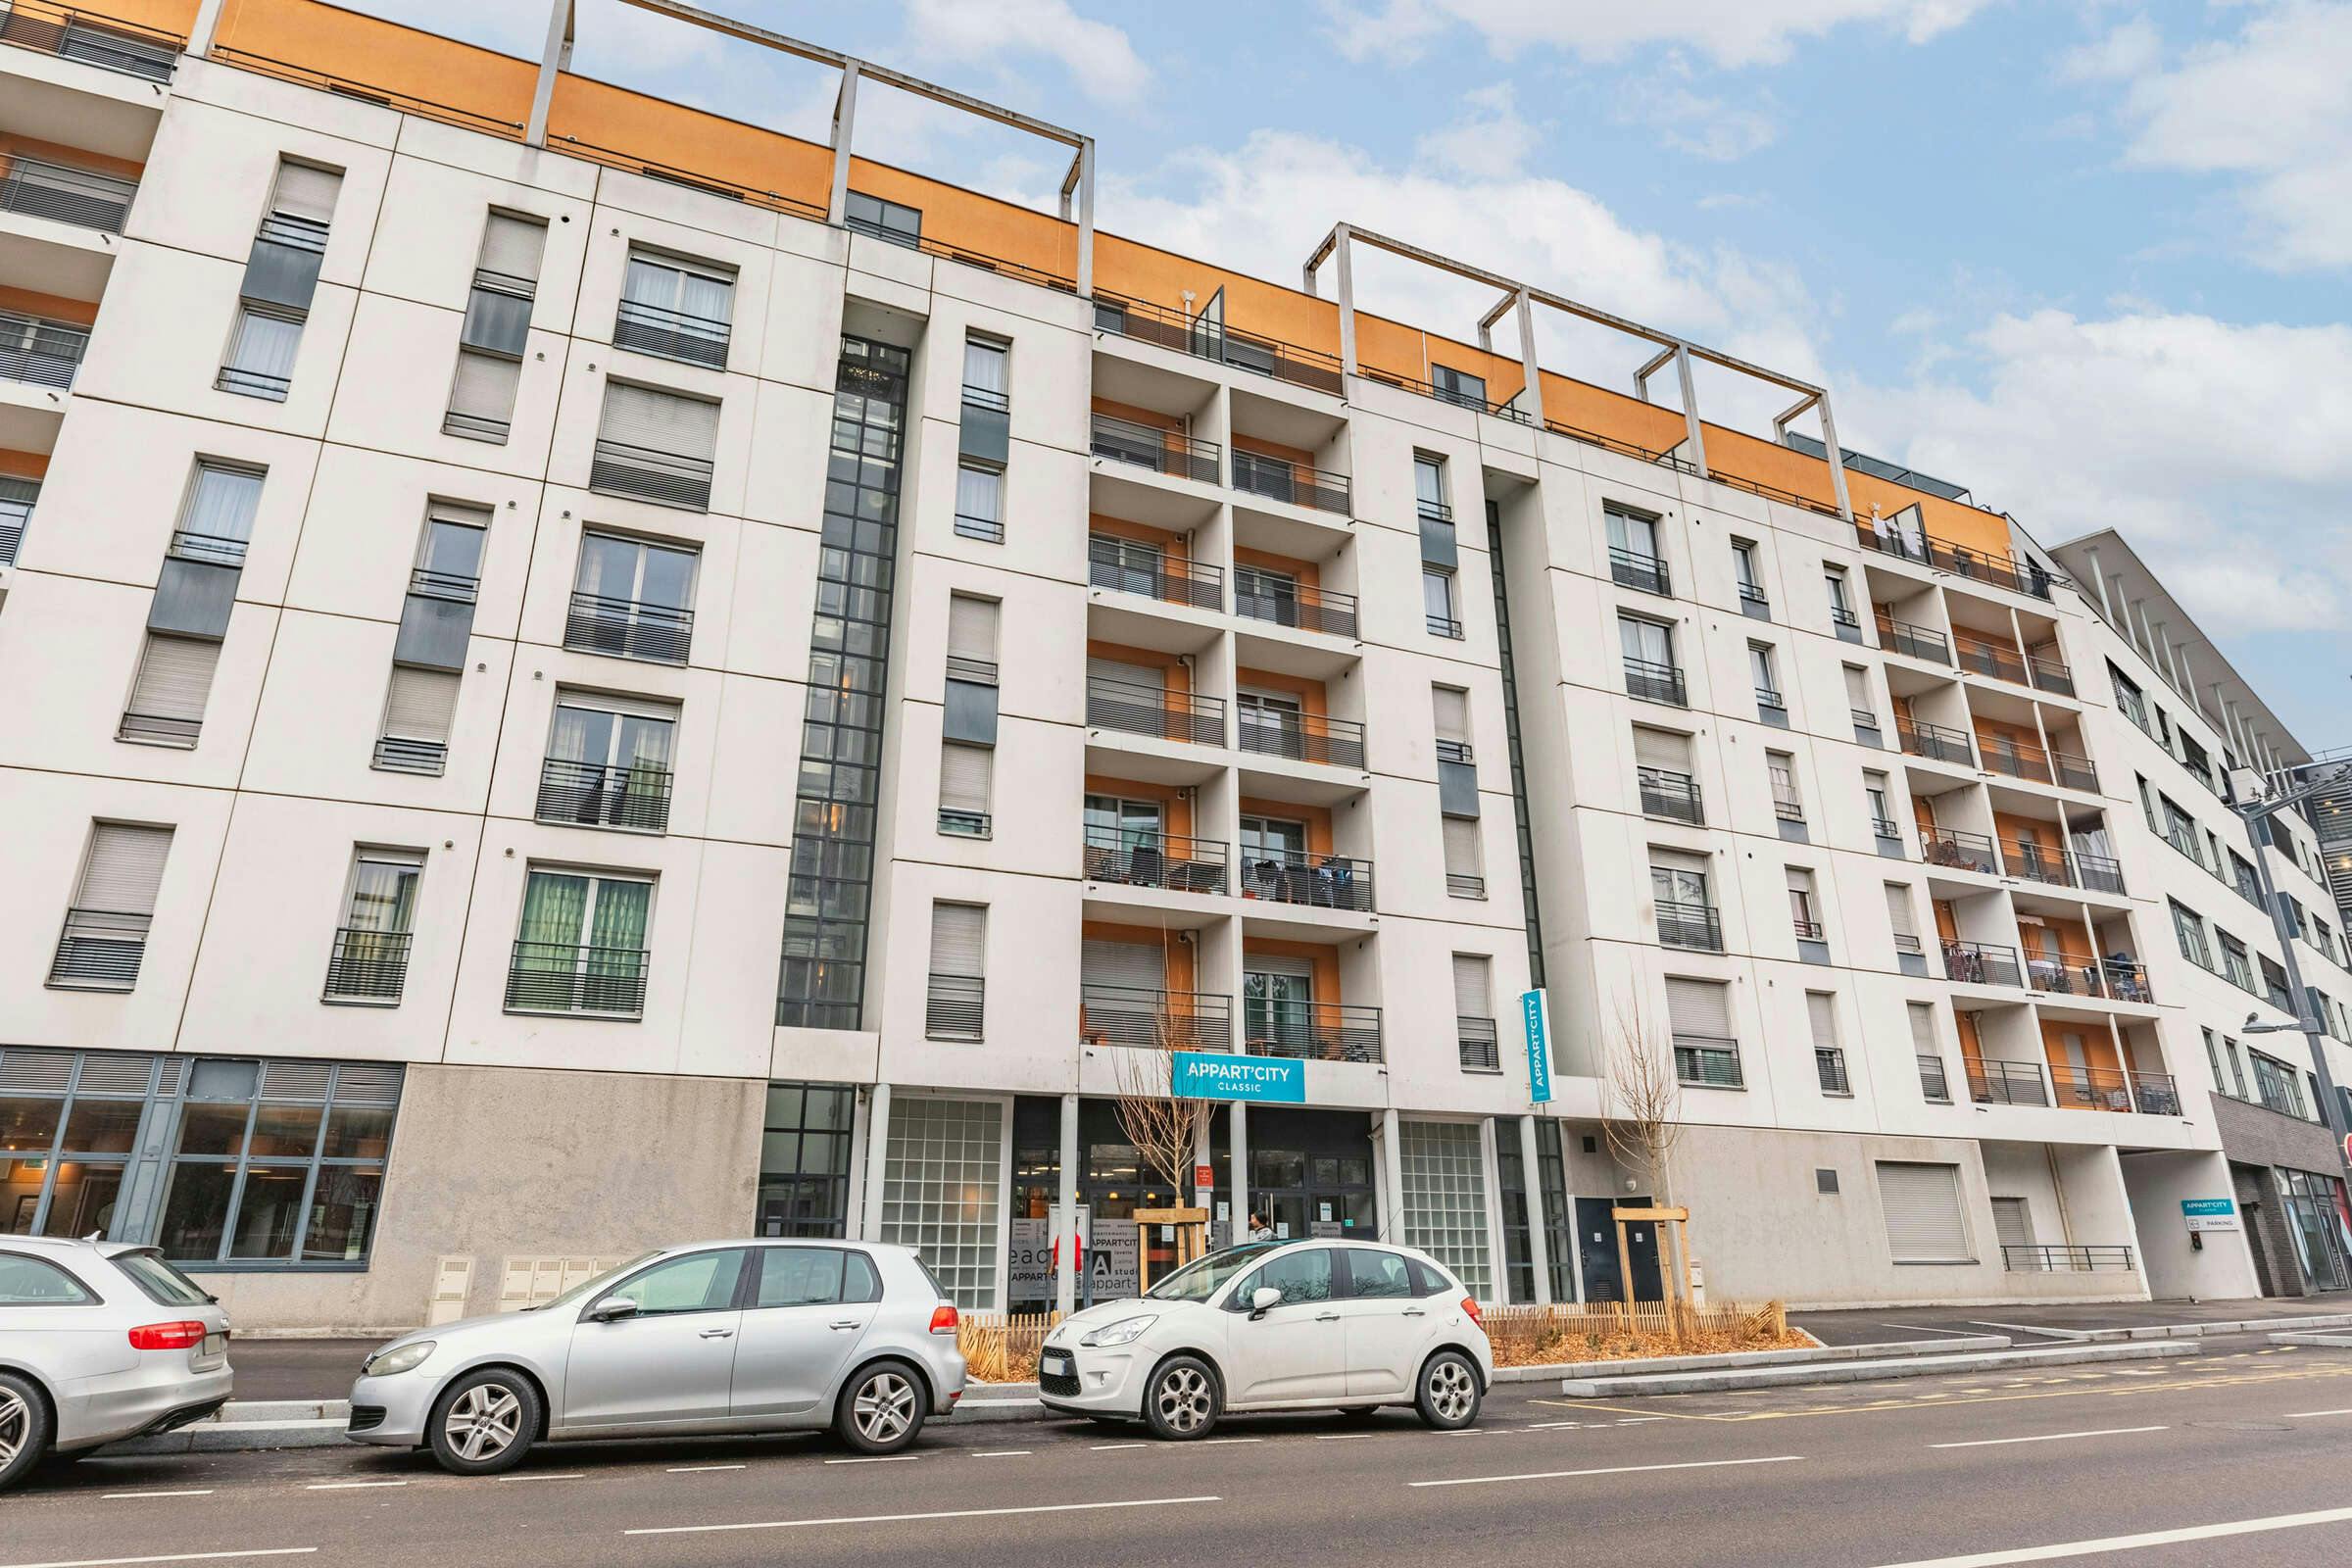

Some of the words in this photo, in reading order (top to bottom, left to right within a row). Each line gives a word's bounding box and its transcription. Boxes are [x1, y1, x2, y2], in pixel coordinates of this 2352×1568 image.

[1529, 999, 1544, 1087] APPART'CITY
[1187, 1062, 1290, 1082] APPART'CITY
[1218, 1082, 1261, 1093] CLASSIC
